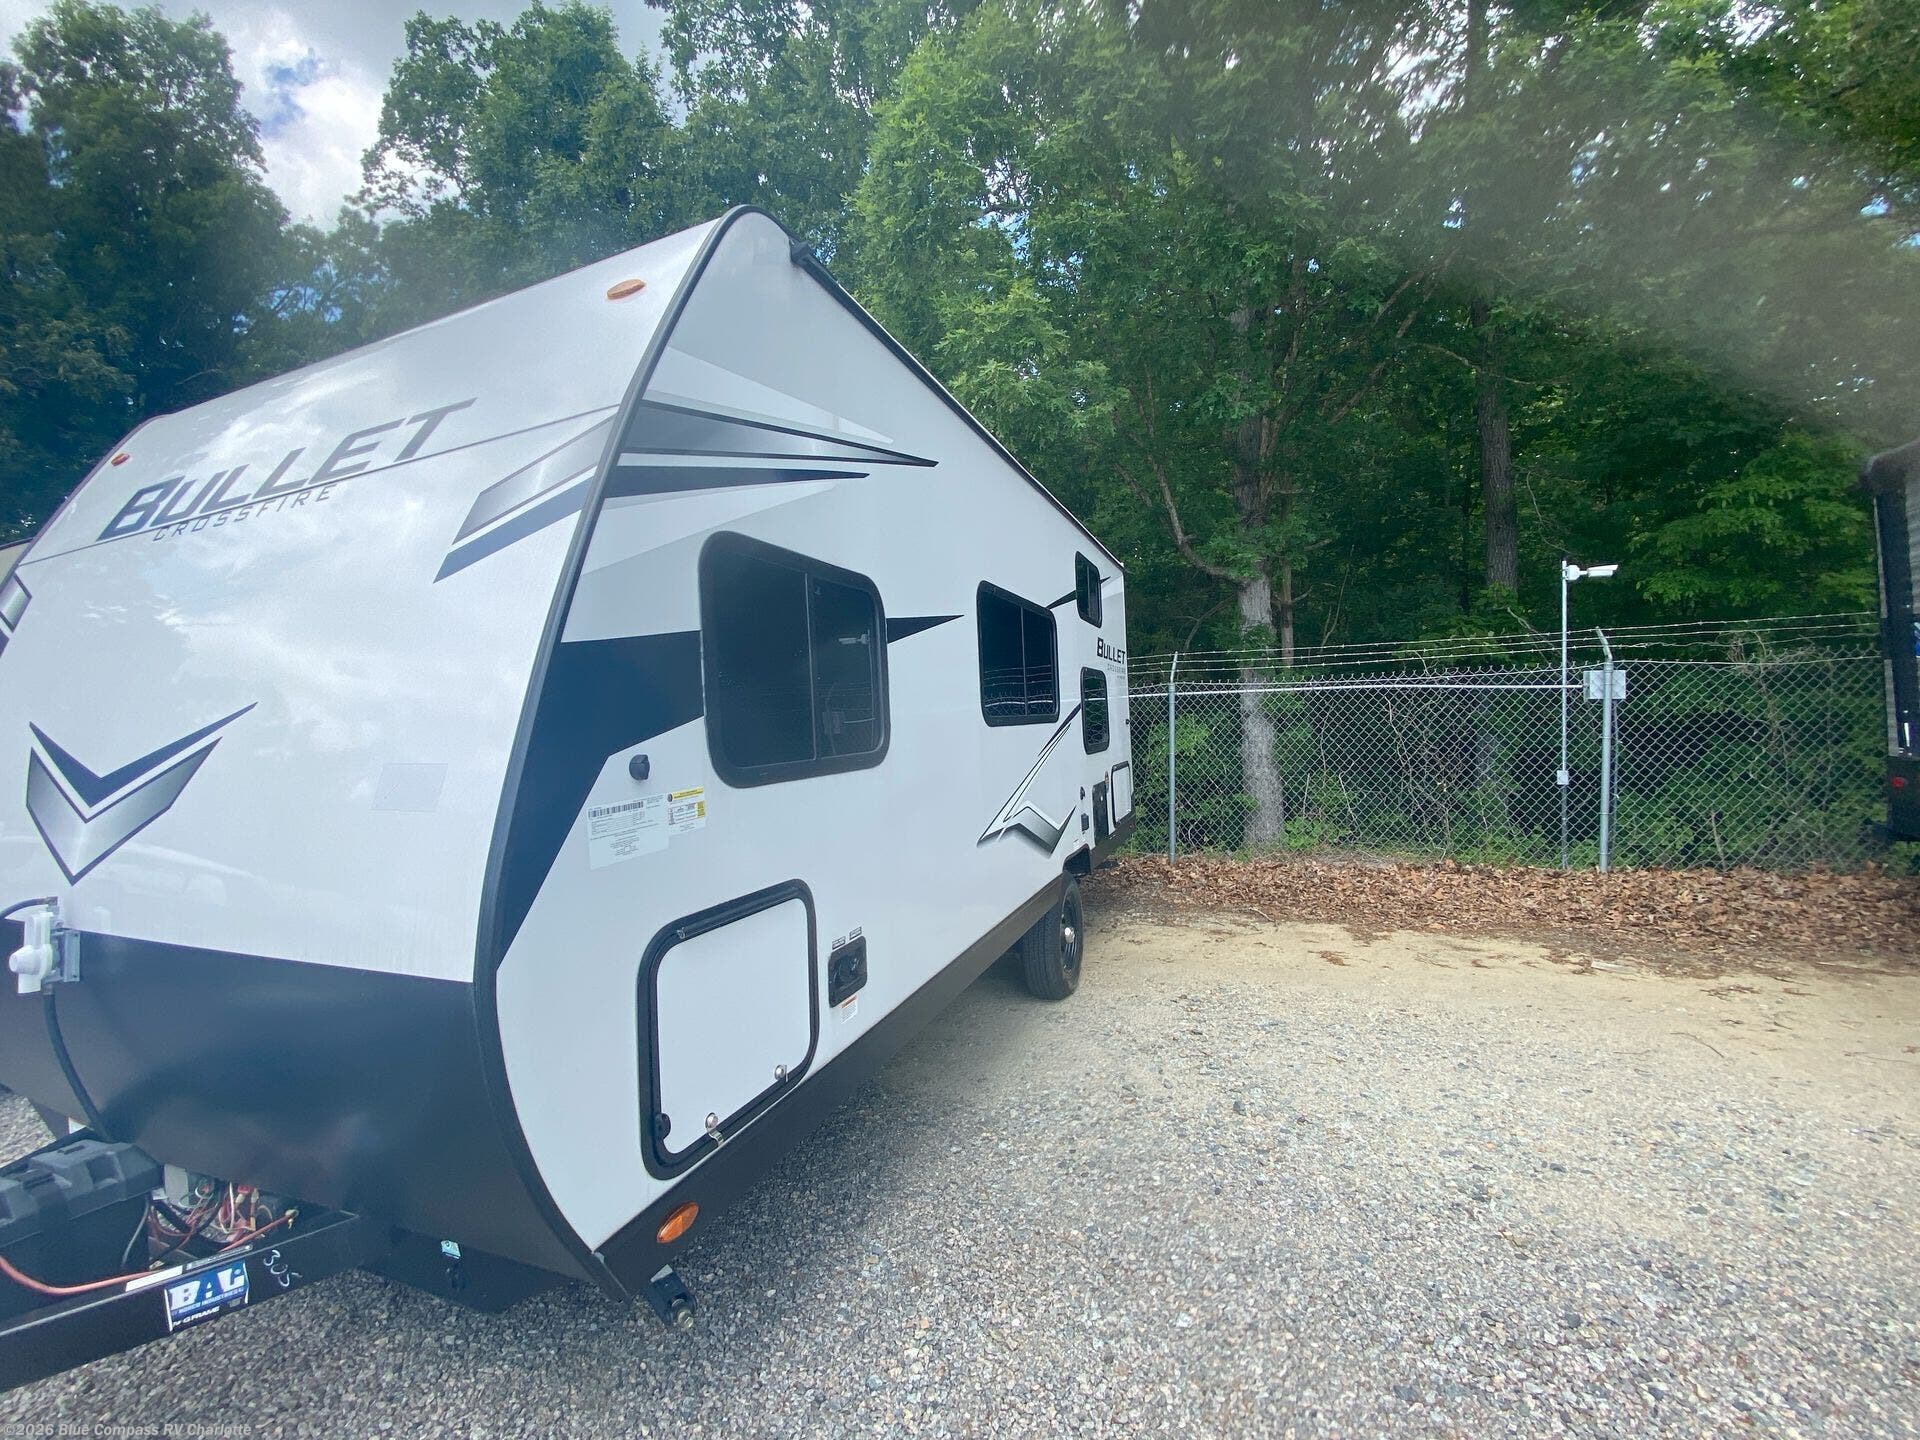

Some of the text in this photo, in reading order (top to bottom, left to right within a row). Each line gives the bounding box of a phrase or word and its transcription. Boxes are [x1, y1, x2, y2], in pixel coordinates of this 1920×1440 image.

[96, 397, 478, 541] BULLET
[153, 484, 339, 541] CROSSFIRE
[1097, 637, 1125, 664] BULLET
[168, 1267, 246, 1311] BAL
